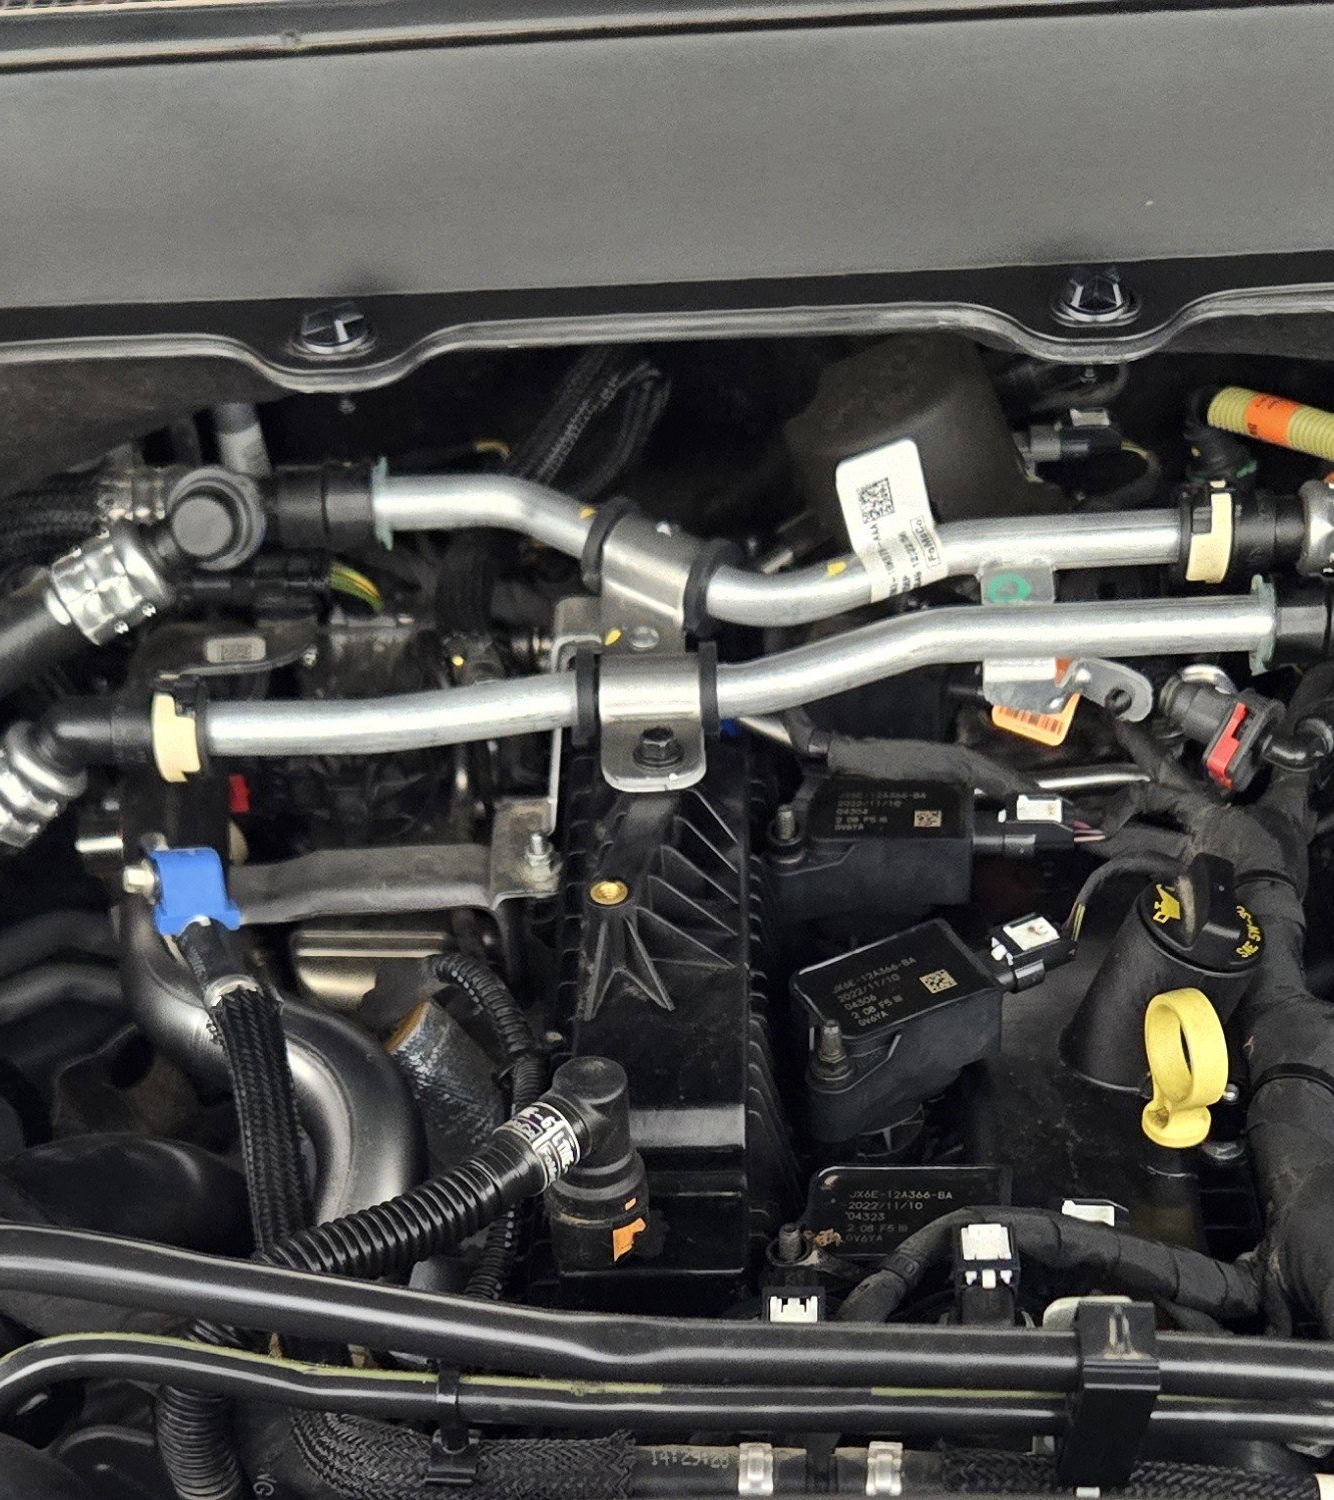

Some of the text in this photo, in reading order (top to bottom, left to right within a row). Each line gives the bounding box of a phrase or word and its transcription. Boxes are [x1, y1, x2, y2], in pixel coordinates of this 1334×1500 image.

[1235, 940, 1259, 958] SAE
[837, 973, 901, 1003] 2022/11/10
[849, 1190, 953, 1200] JX6E-12A366-BA
[847, 1201, 924, 1211] 2022/11/10
[847, 1212, 885, 1222] 04323
